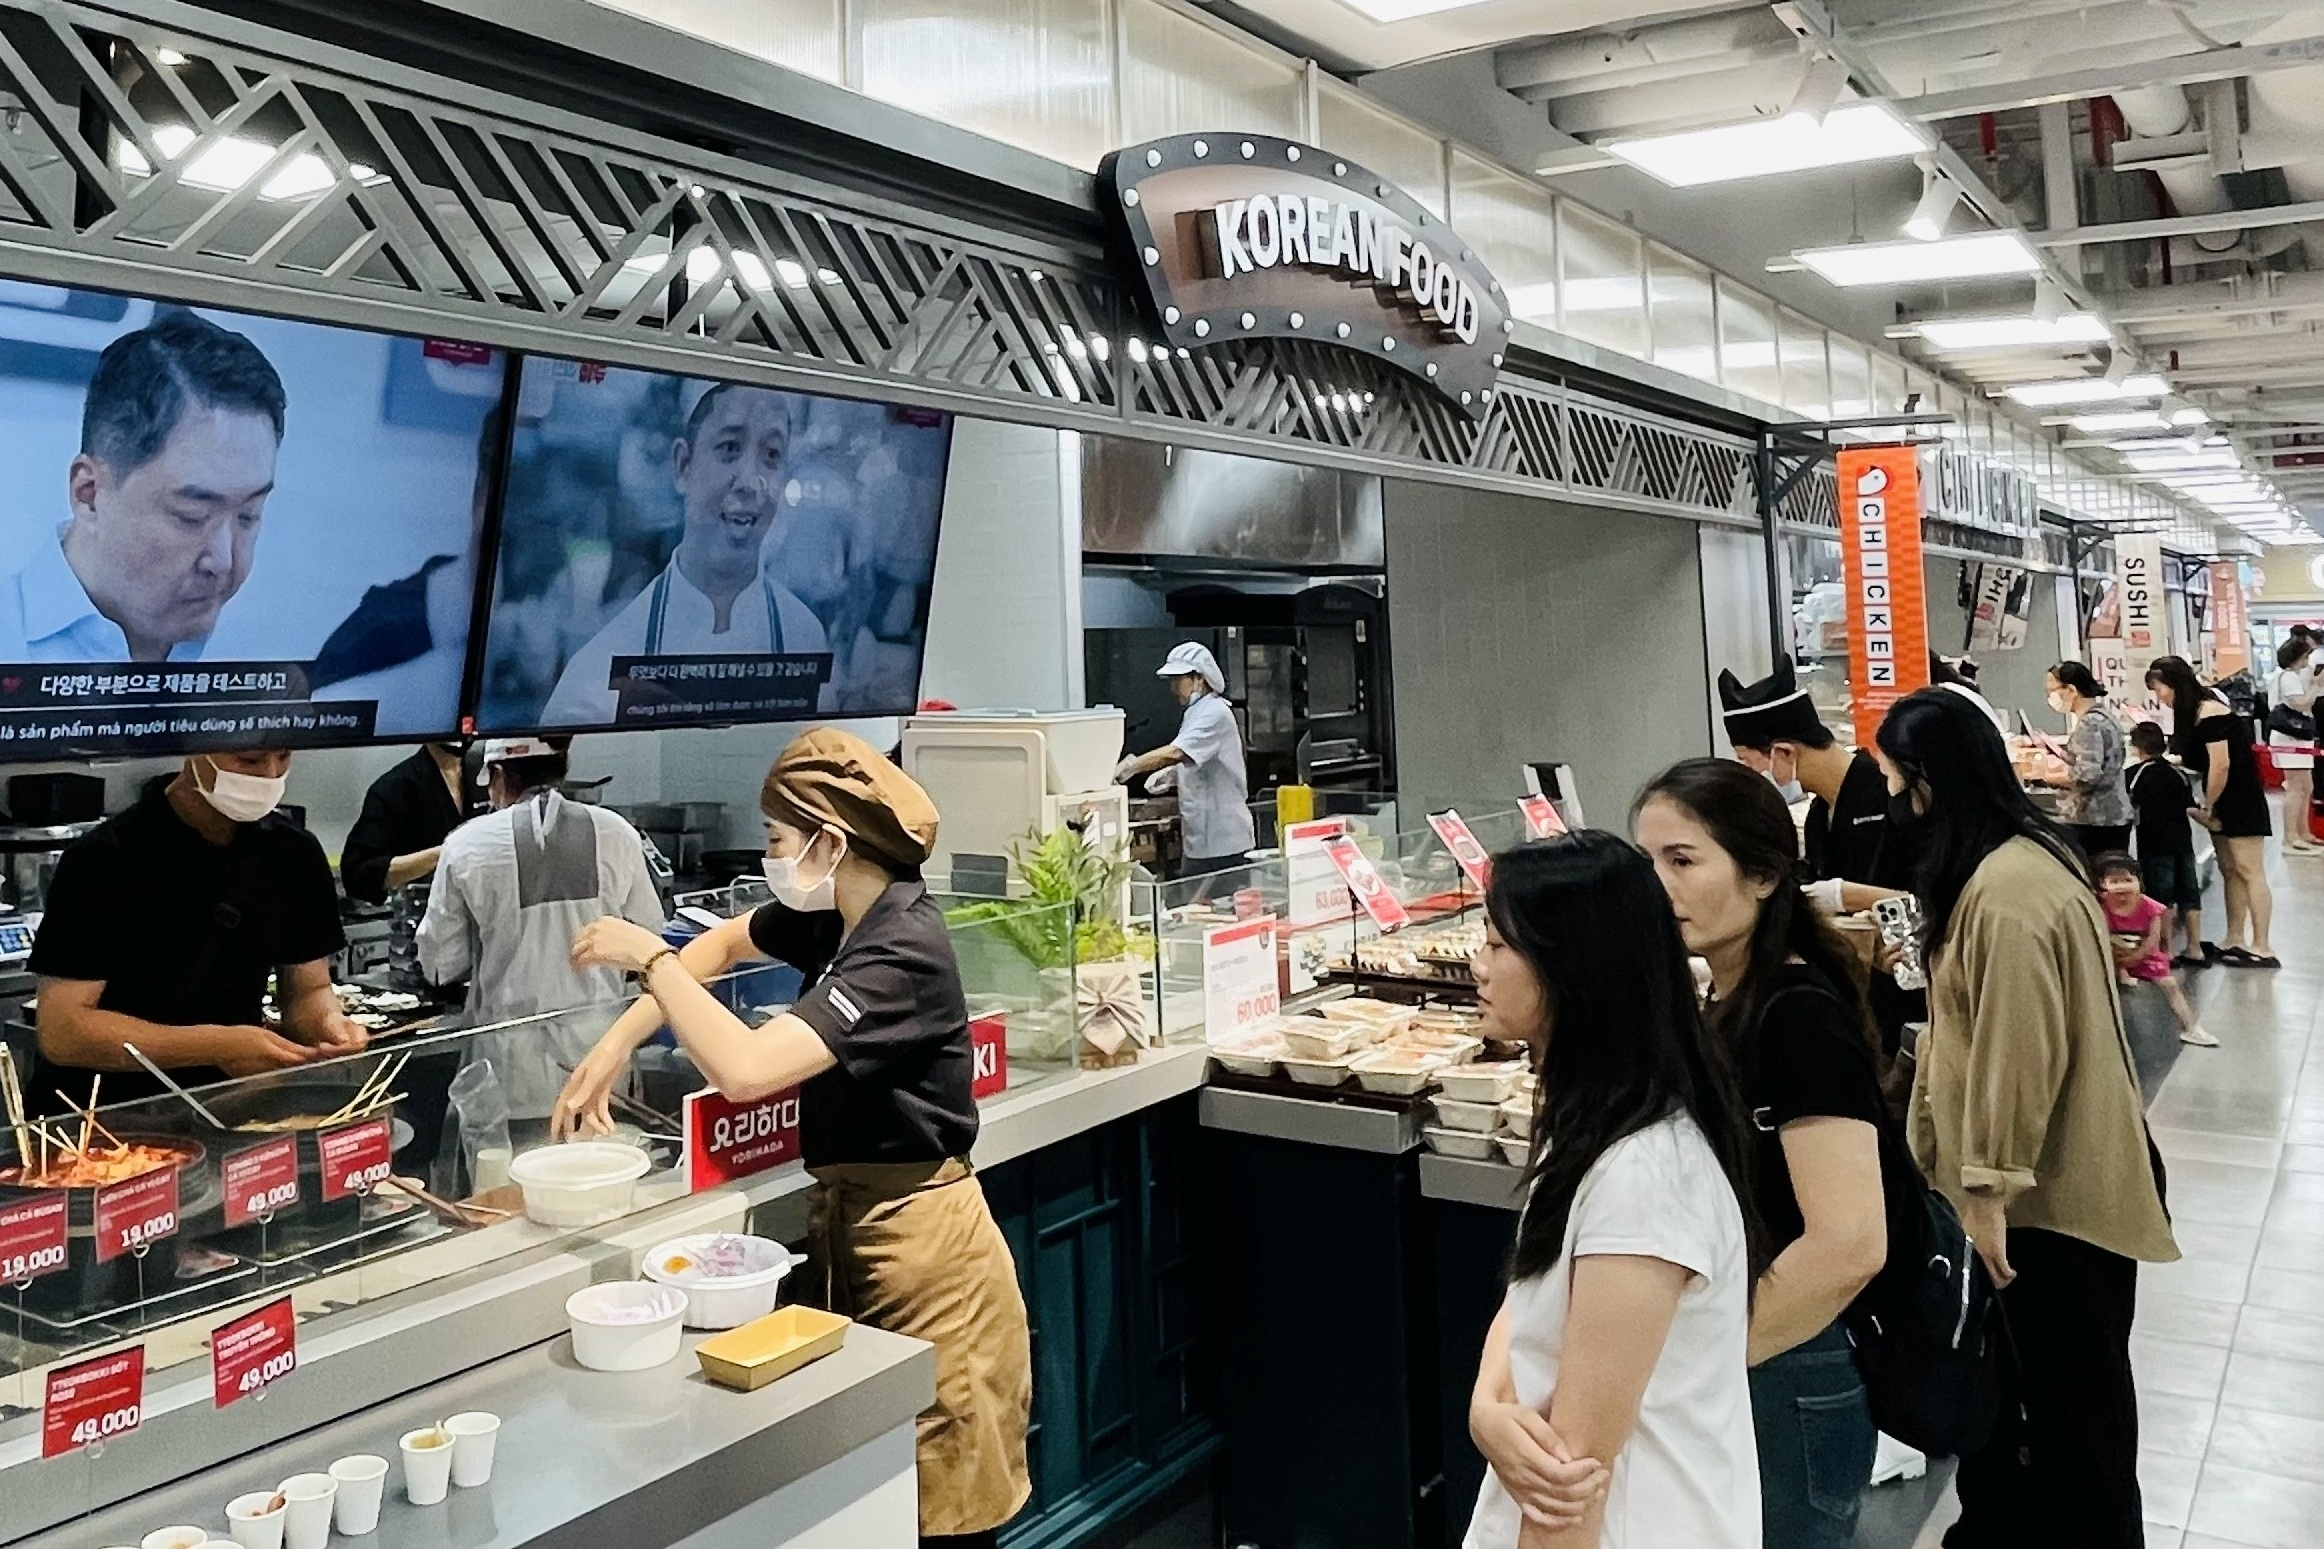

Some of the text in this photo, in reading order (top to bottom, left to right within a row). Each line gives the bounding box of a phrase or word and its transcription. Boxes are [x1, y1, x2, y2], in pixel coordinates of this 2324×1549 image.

[1215, 193, 1479, 346] KOREAN FOOD
[1862, 502, 1891, 681] CHICKEN
[2125, 557, 2149, 626] SUSHI
[40, 671, 287, 696] 다양한 부분으로 제품을 테스트하고
[2106, 657, 2126, 670] QU
[50, 719, 93, 740] phẩm
[124, 719, 166, 737] người
[170, 718, 197, 732] tiêu
[200, 717, 236, 732] dùng
[258, 714, 290, 729] thích
[293, 715, 316, 730] hay
[973, 1041, 997, 1081] KI
